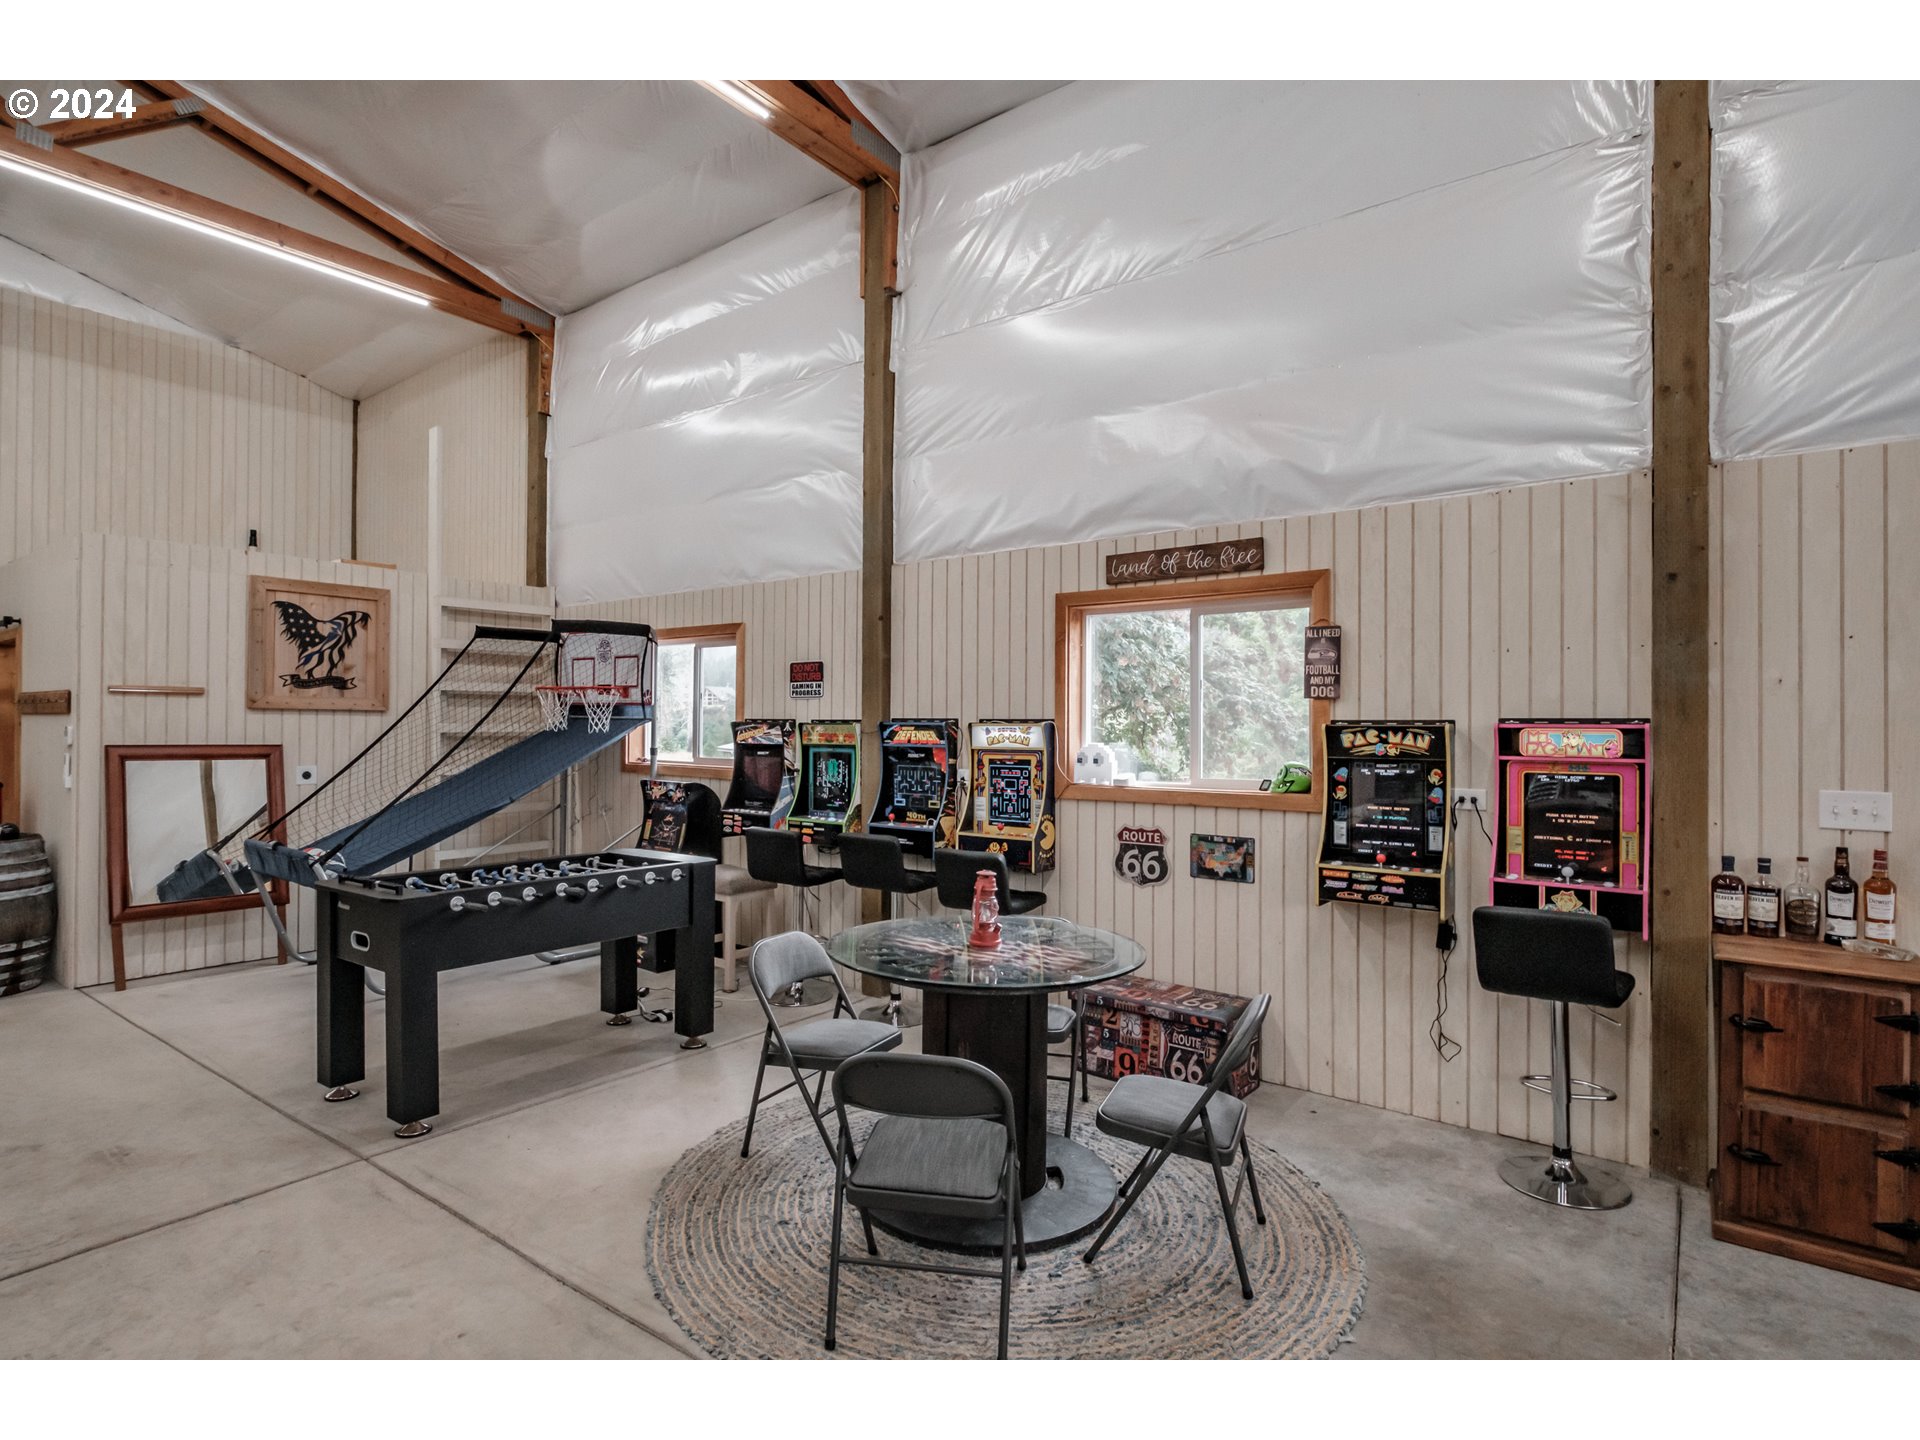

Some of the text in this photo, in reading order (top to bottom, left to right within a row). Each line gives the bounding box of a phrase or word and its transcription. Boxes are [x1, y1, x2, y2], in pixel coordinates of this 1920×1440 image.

[1160, 552, 1179, 575] of
[1184, 549, 1216, 570] the
[1219, 545, 1261, 569] free
[1306, 629, 1319, 638] ALL
[1322, 628, 1341, 638] NEED
[793, 663, 820, 673] DO NOT
[1305, 664, 1340, 675] FOOTBALL
[792, 672, 822, 682] DISTURB
[1310, 675, 1336, 685] AND MY
[815, 682, 822, 690] IN
[1310, 685, 1335, 698] DOG
[791, 689, 822, 697] PROGRESS
[893, 730, 941, 745] DEFENDER
[986, 733, 1031, 747] PAC-MAN
[1340, 727, 1431, 751] PAC-MAN
[906, 811, 927, 820] 40TH
[1122, 830, 1161, 843] ROUTE
[1122, 848, 1161, 880] 66
[1096, 995, 1104, 1006] 5
[1182, 996, 1218, 1010] 66
[1105, 1009, 1118, 1026] 2
[1103, 1028, 1110, 1039] 5
[1172, 1033, 1202, 1049] ROUTE
[1118, 1052, 1136, 1077] 9
[1170, 1049, 1204, 1084] 66
